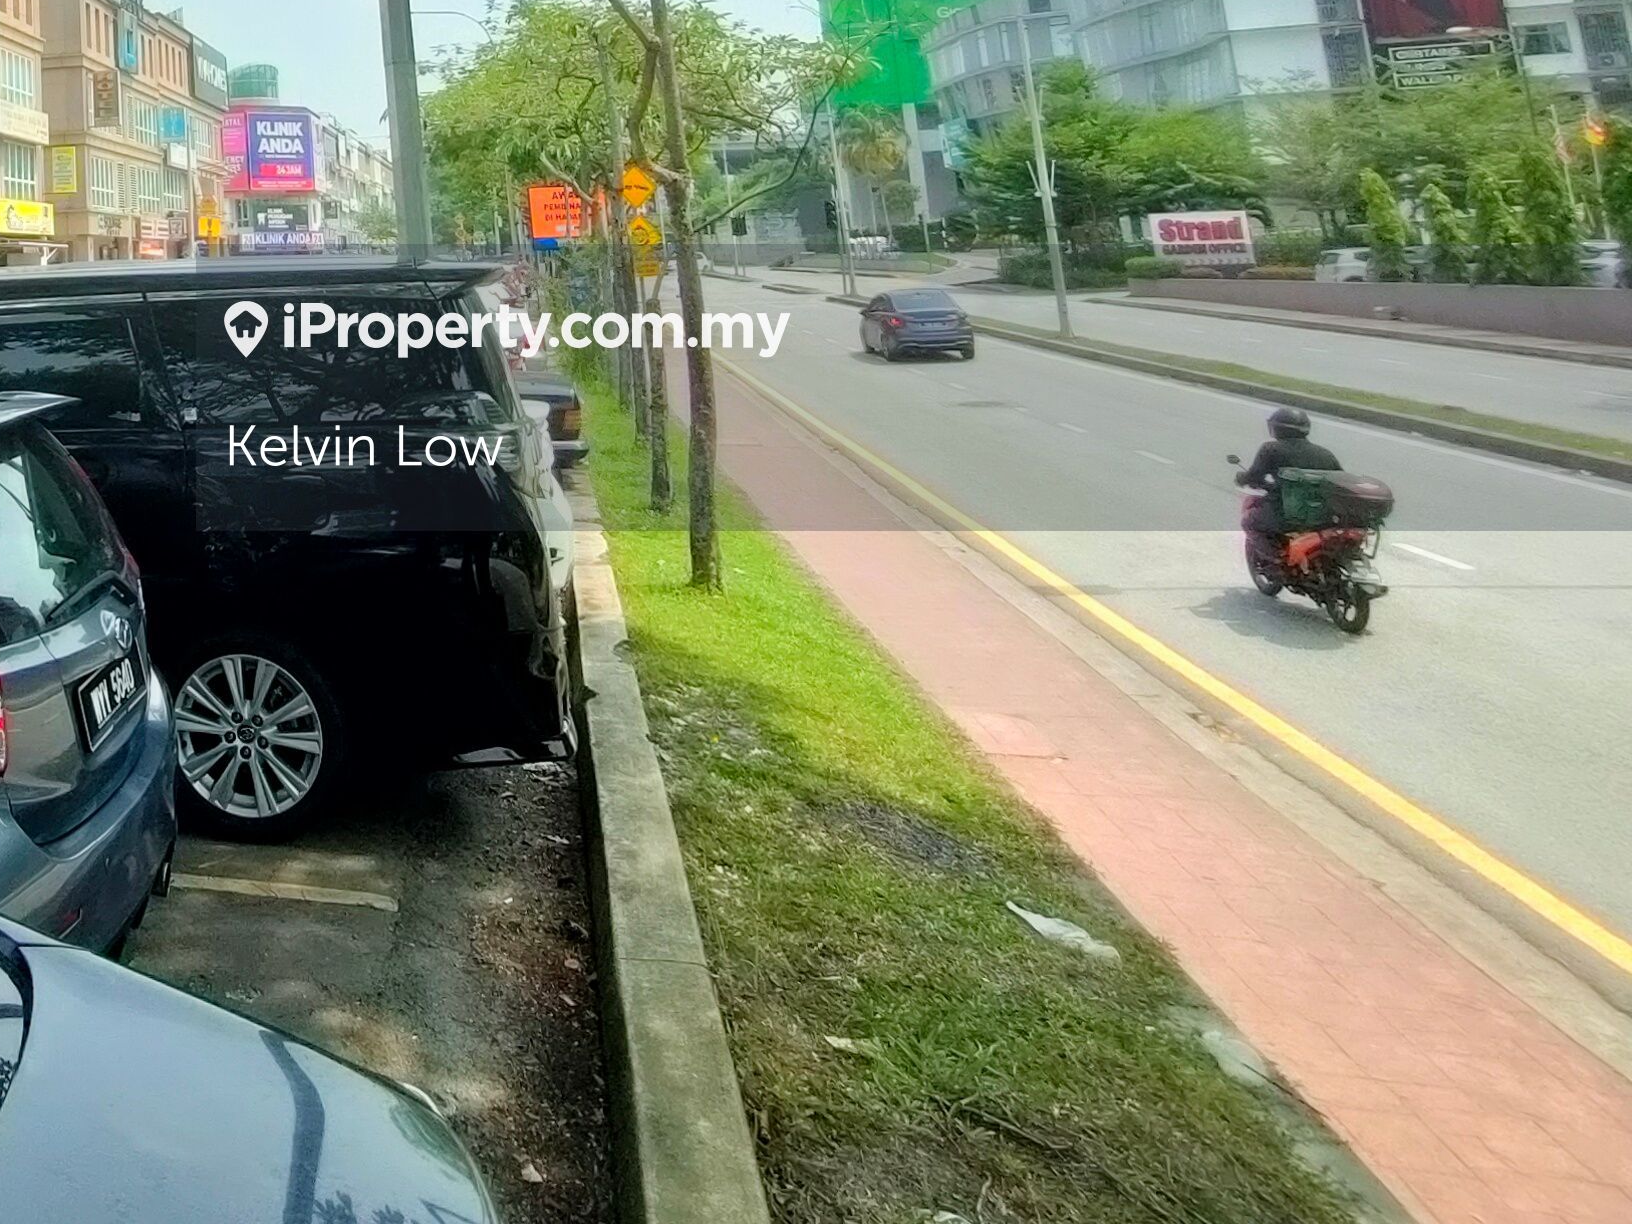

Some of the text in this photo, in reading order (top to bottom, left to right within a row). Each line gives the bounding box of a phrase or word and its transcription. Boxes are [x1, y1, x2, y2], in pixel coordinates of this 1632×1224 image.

[256, 121, 303, 137] KLINIK
[258, 137, 304, 154] ANDA
[1158, 216, 1244, 243] Strand
[255, 232, 285, 245] KLINIK
[287, 232, 311, 245] ANDA
